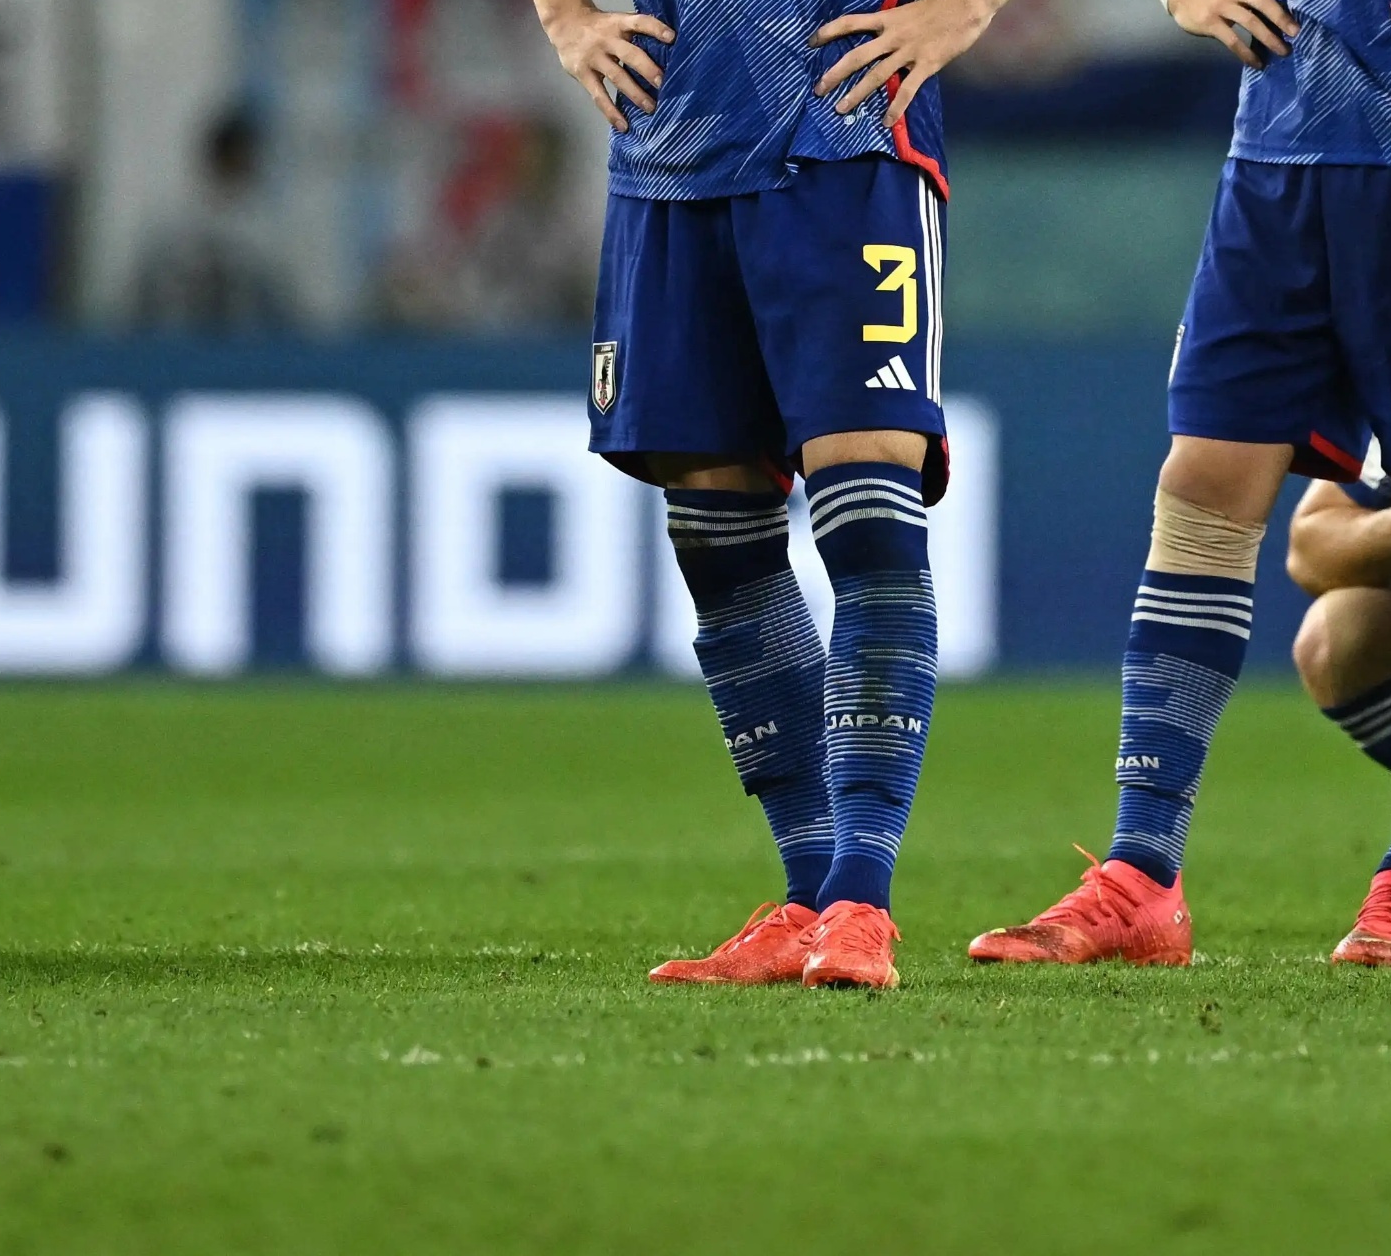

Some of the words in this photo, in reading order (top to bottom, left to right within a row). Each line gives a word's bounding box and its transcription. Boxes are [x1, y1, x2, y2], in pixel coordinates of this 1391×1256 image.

[862, 244, 917, 344] 3
[725, 720, 779, 750] PAN
[826, 713, 922, 734] JAPAN
[1115, 755, 1160, 770] PAN
